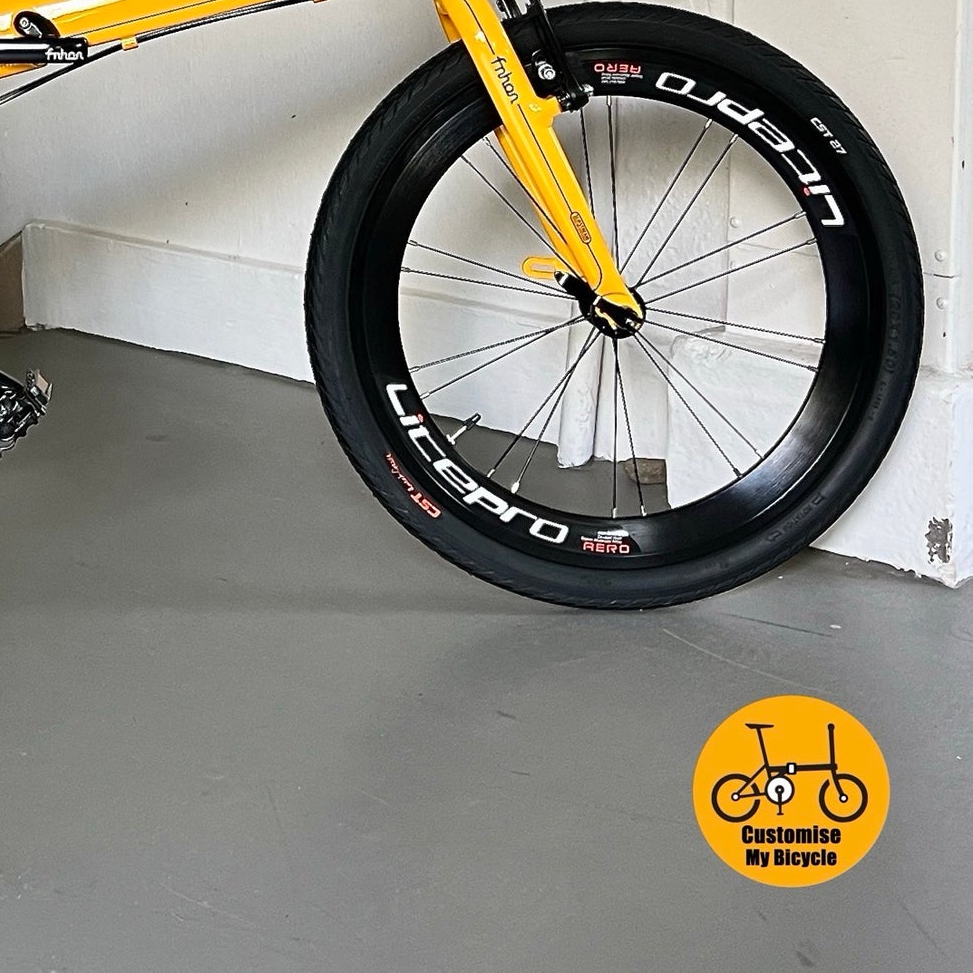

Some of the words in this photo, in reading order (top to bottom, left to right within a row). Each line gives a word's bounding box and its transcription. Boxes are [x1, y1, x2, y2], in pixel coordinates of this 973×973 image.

[45, 48, 84, 61] fnhon
[593, 63, 641, 74] AERO
[491, 55, 519, 105] fnhon
[810, 117, 834, 139] CST
[830, 139, 848, 155] 27
[409, 492, 441, 518] CST
[583, 541, 630, 554] AERO
